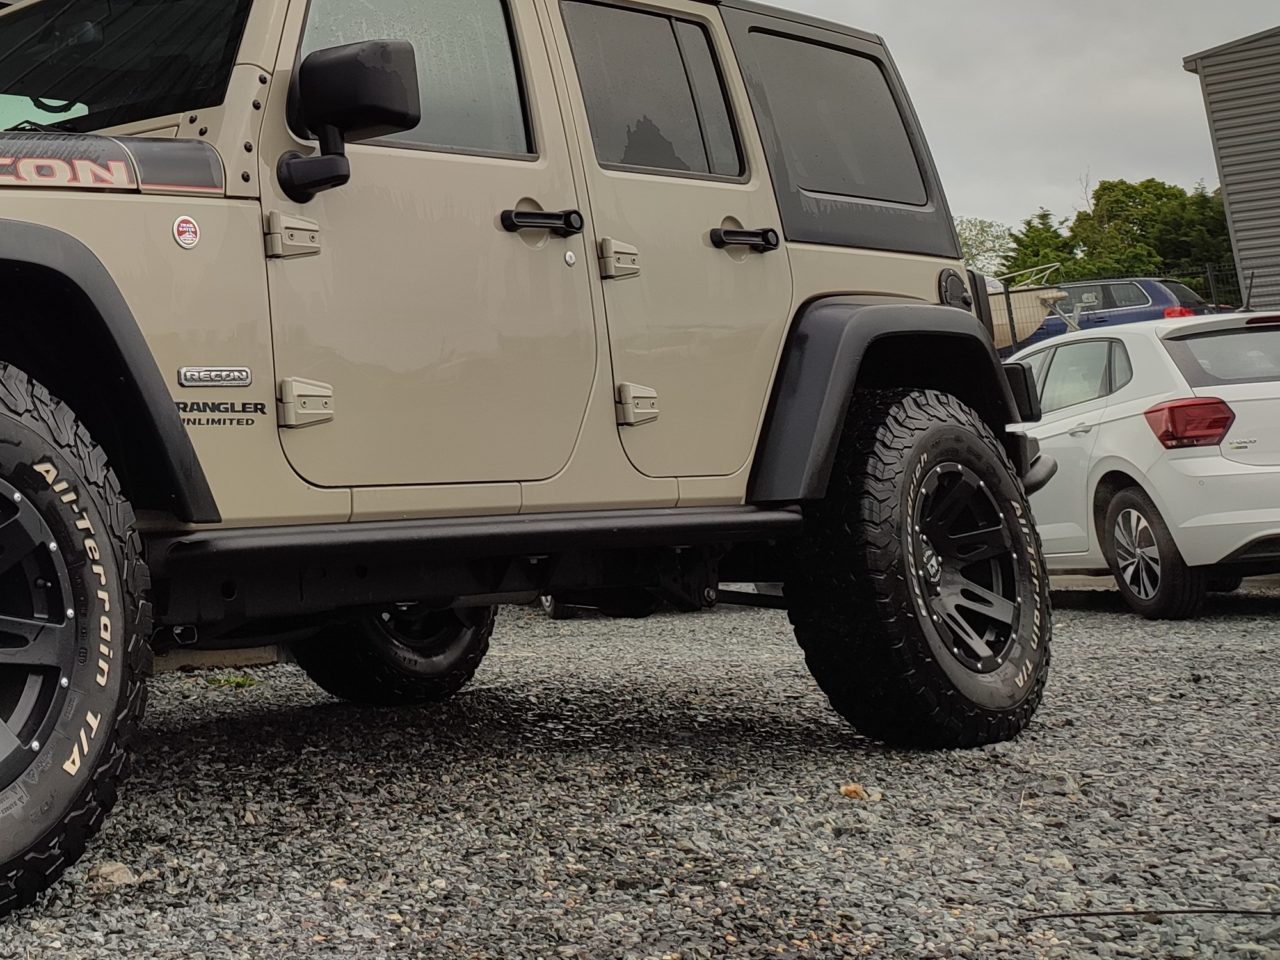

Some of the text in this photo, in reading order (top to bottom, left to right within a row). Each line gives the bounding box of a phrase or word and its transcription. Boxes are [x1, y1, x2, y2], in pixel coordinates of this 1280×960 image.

[185, 371, 248, 382] RECON
[174, 401, 267, 415] RANGLER
[32, 462, 110, 688] All-Terrain
[62, 709, 102, 777] T/A
